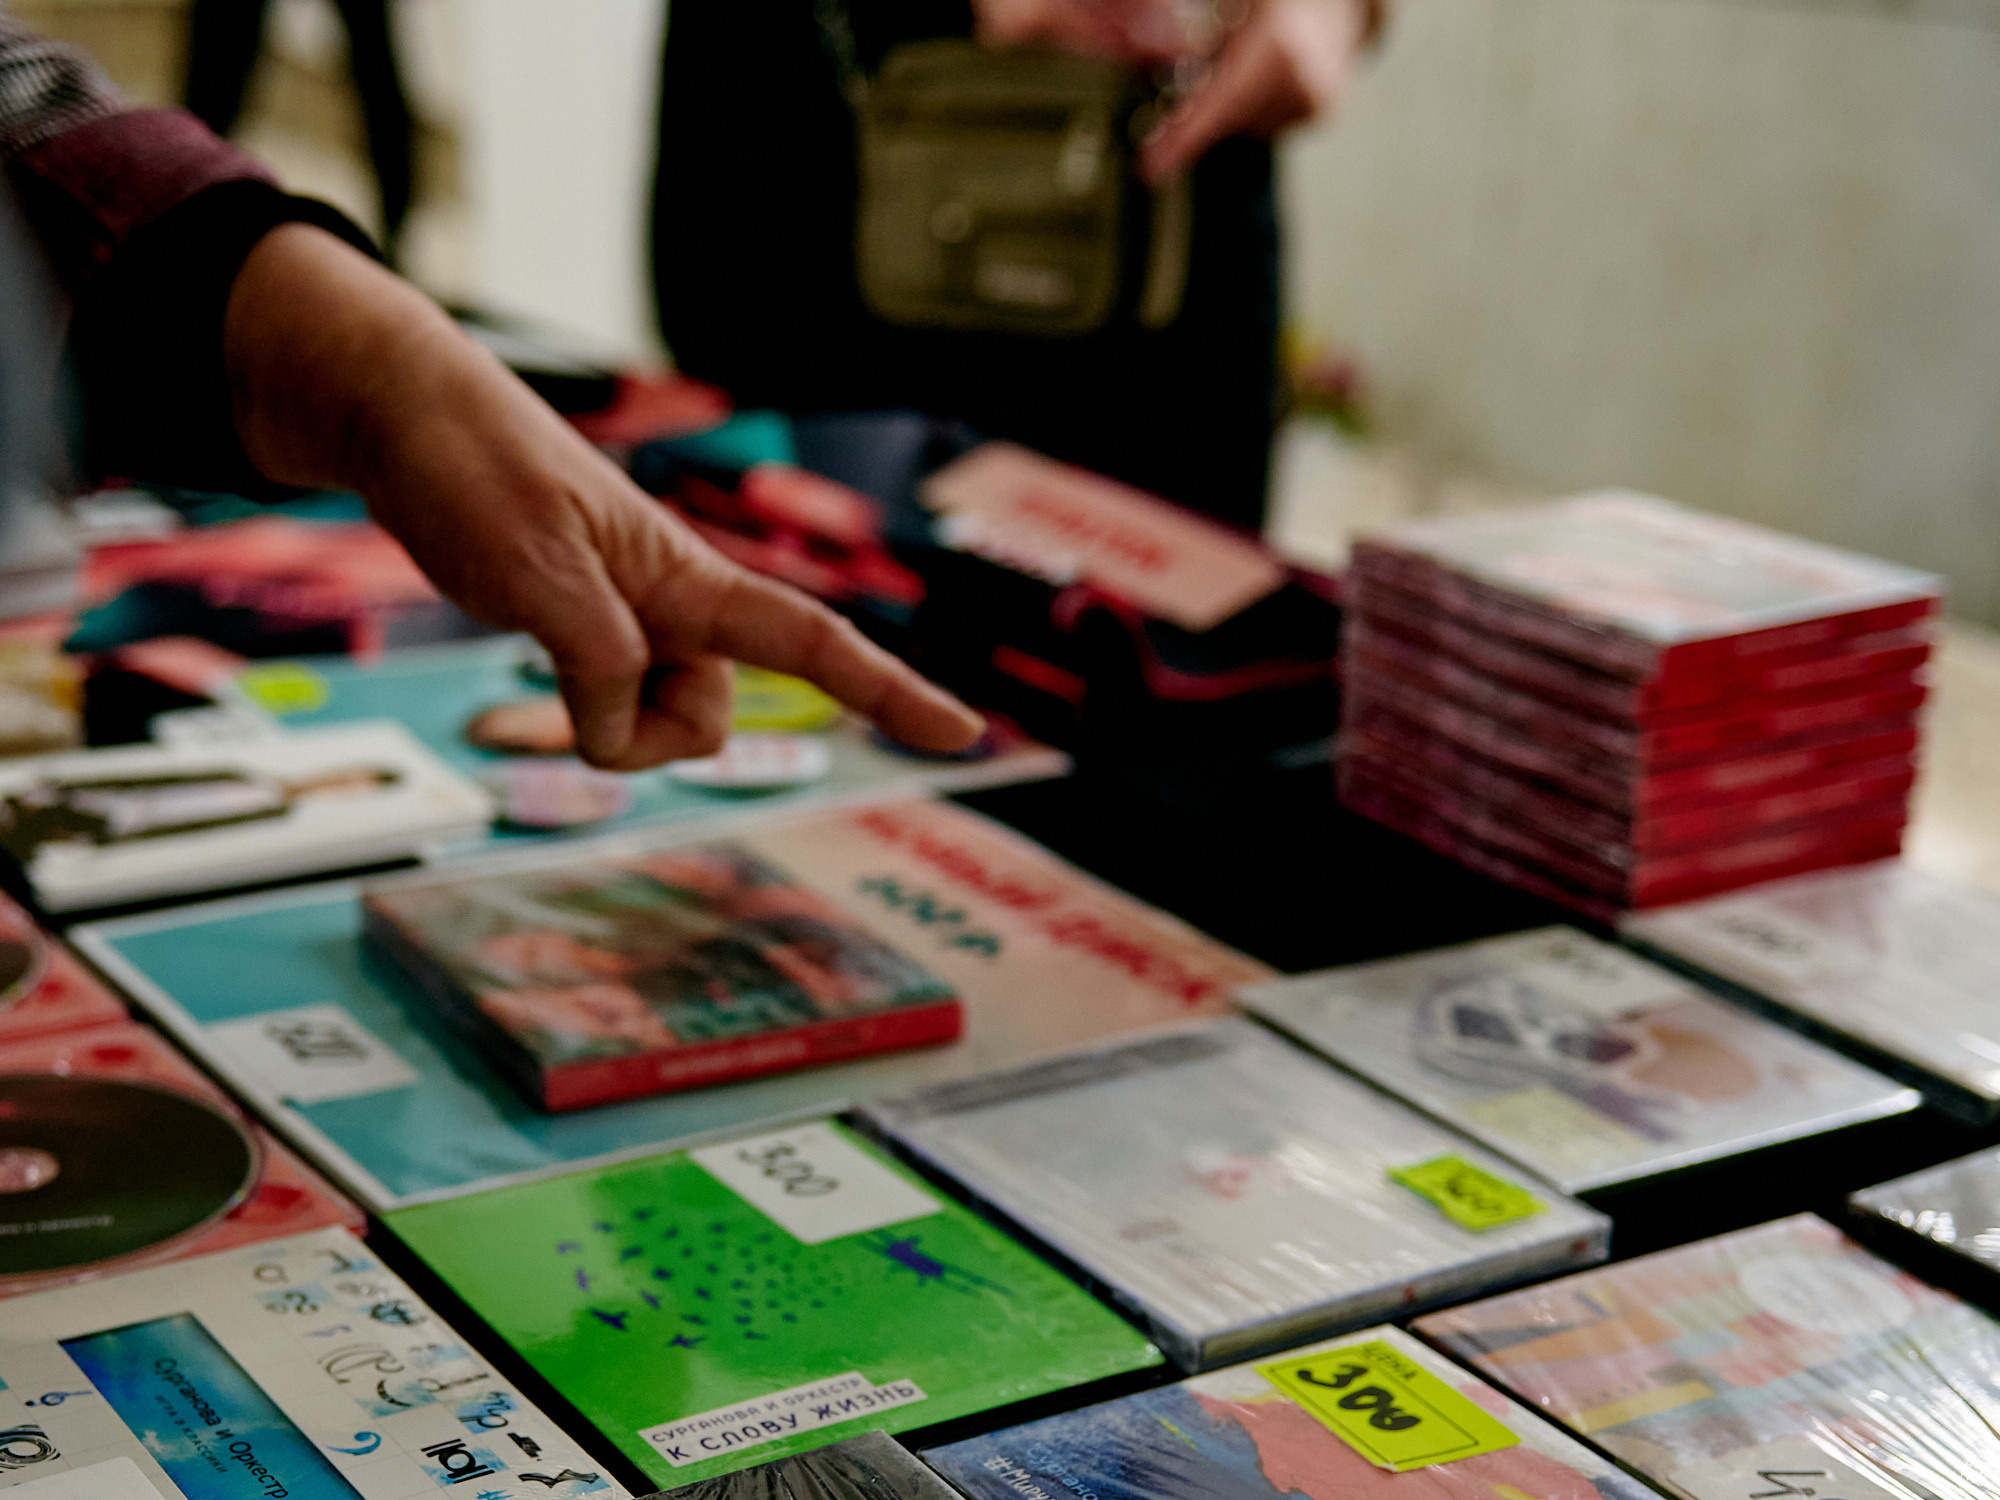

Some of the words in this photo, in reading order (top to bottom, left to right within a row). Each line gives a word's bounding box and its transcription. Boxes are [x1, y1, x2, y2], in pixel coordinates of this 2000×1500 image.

[737, 1142, 840, 1198] 300
[651, 1406, 762, 1443] СУРГАНОВА
[766, 1401, 779, 1412] И
[782, 1378, 861, 1407] ОРКЕСТР
[666, 1445, 690, 1461] К
[699, 1413, 799, 1451] СЛОВУ
[810, 1384, 916, 1422] ЖИЗНЬ
[215, 1428, 234, 1441] и
[228, 1440, 289, 1499] Оркестр
